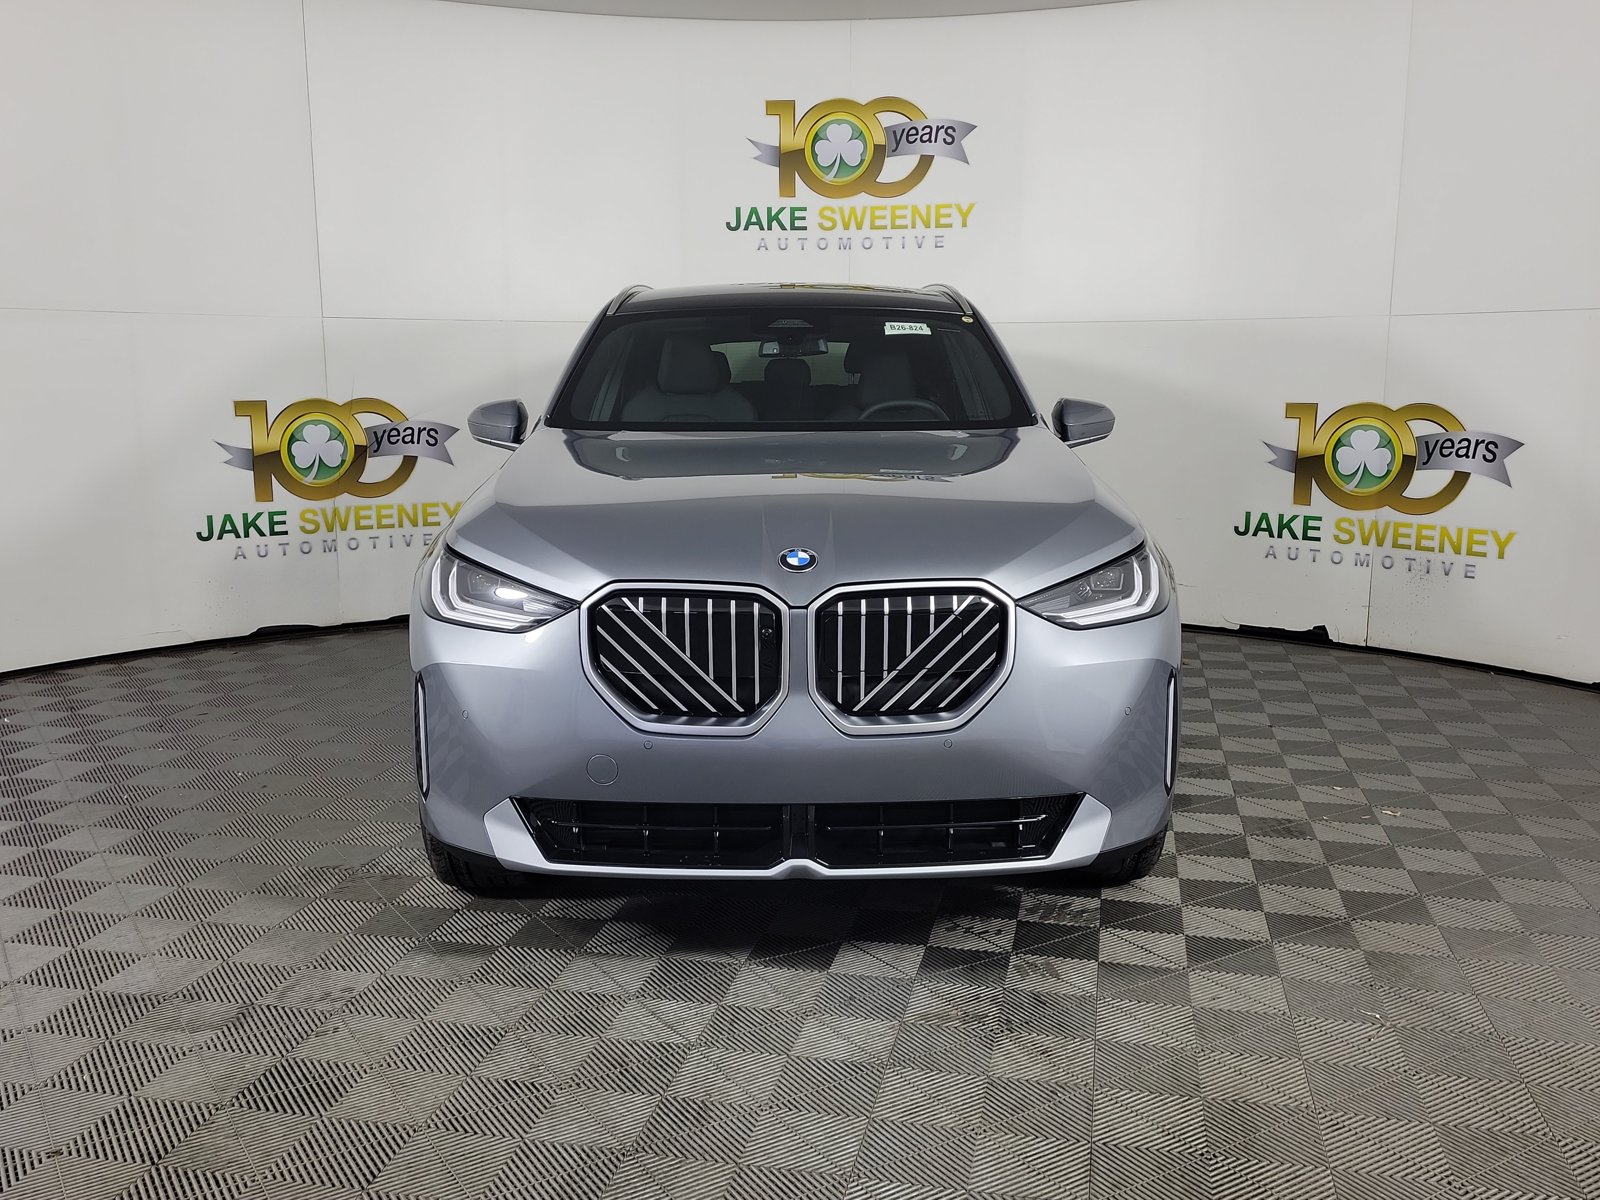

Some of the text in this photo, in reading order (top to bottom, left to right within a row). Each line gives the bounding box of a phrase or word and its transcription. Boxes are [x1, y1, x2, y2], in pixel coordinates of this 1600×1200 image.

[891, 124, 957, 153] years
[725, 202, 976, 232] JAKE SWEENEY
[756, 235, 945, 251] AUTOMOTIVE
[372, 425, 440, 453] years
[1421, 437, 1499, 466] years
[196, 510, 289, 542] JAKE
[1233, 511, 1518, 560] JAKE SWEENEY
[233, 533, 433, 561] AUTOMOTIVE
[1264, 545, 1476, 580] AUTOMOTIVE
